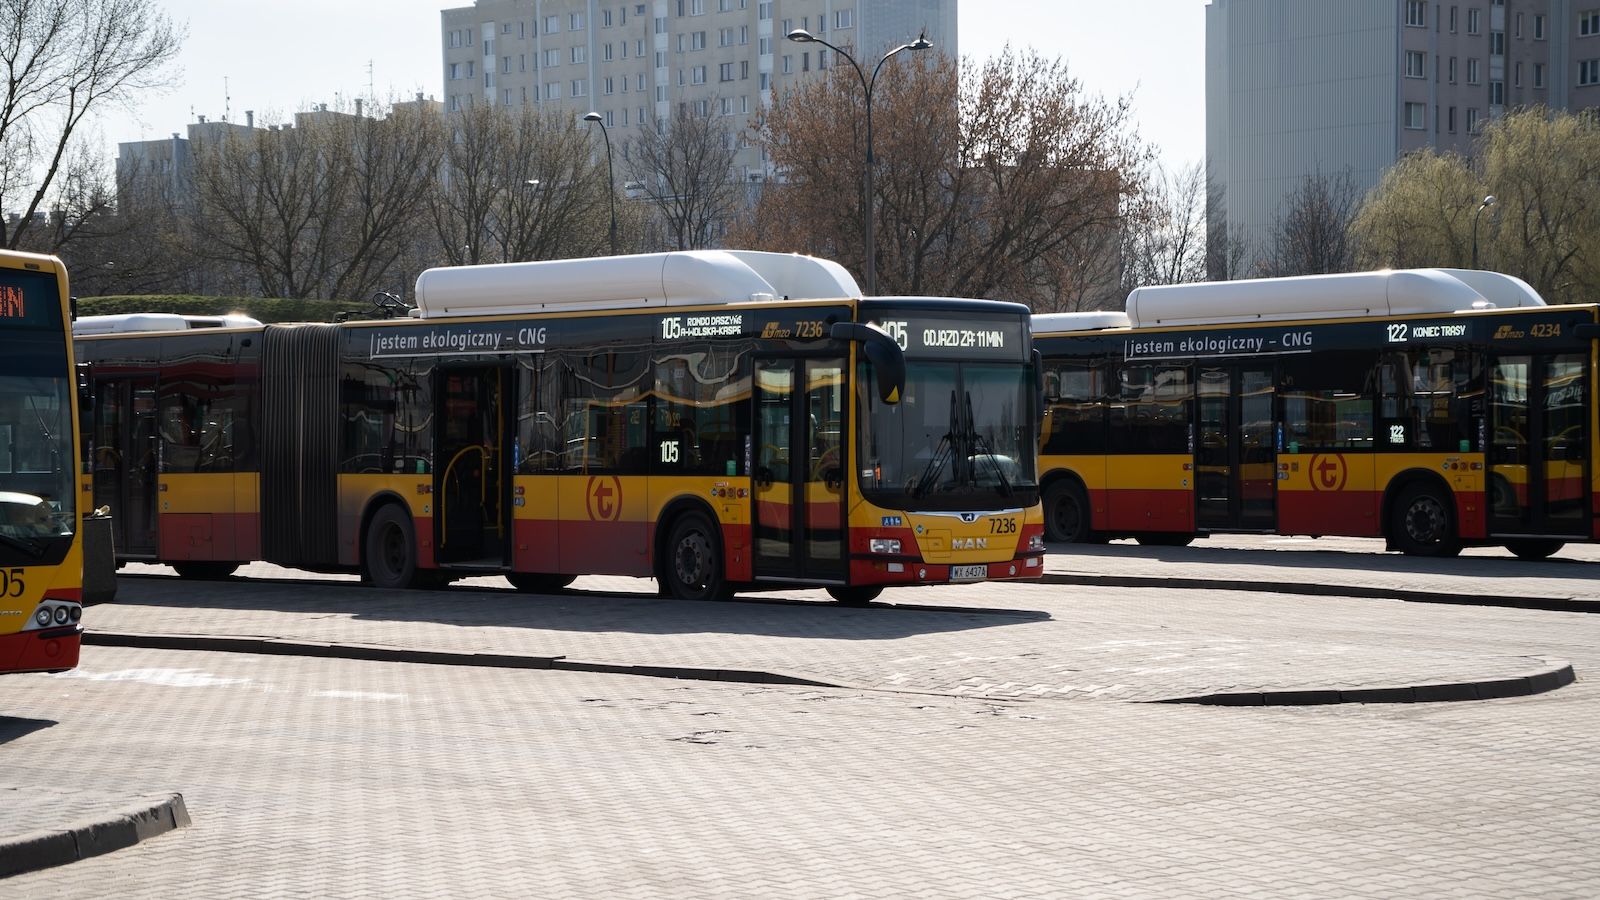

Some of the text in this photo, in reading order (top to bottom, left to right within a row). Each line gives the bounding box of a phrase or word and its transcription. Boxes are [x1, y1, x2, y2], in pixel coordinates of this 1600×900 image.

[0, 286, 24, 318] IN
[661, 316, 681, 340] 105
[687, 316, 710, 328] RONDO
[795, 320, 823, 338] 7236
[1412, 324, 1466, 338] KONIEC TRASY
[1530, 323, 1561, 338] 4234
[376, 333, 418, 354] jestem
[422, 329, 501, 351] ekologiczny
[518, 327, 547, 345] CNG
[923, 329, 959, 347] ODJAZD
[977, 331, 986, 347] 11
[986, 331, 1003, 348] MIN
[1387, 323, 1408, 343] 122
[1130, 340, 1174, 357] jestem
[1179, 336, 1263, 353] ekologiczny
[1282, 331, 1312, 347] CNG
[1390, 424, 1404, 438] 122
[660, 440, 679, 463] 105
[989, 518, 1017, 534] 7236
[952, 537, 987, 550] MAN
[965, 565, 986, 578] 6437A
